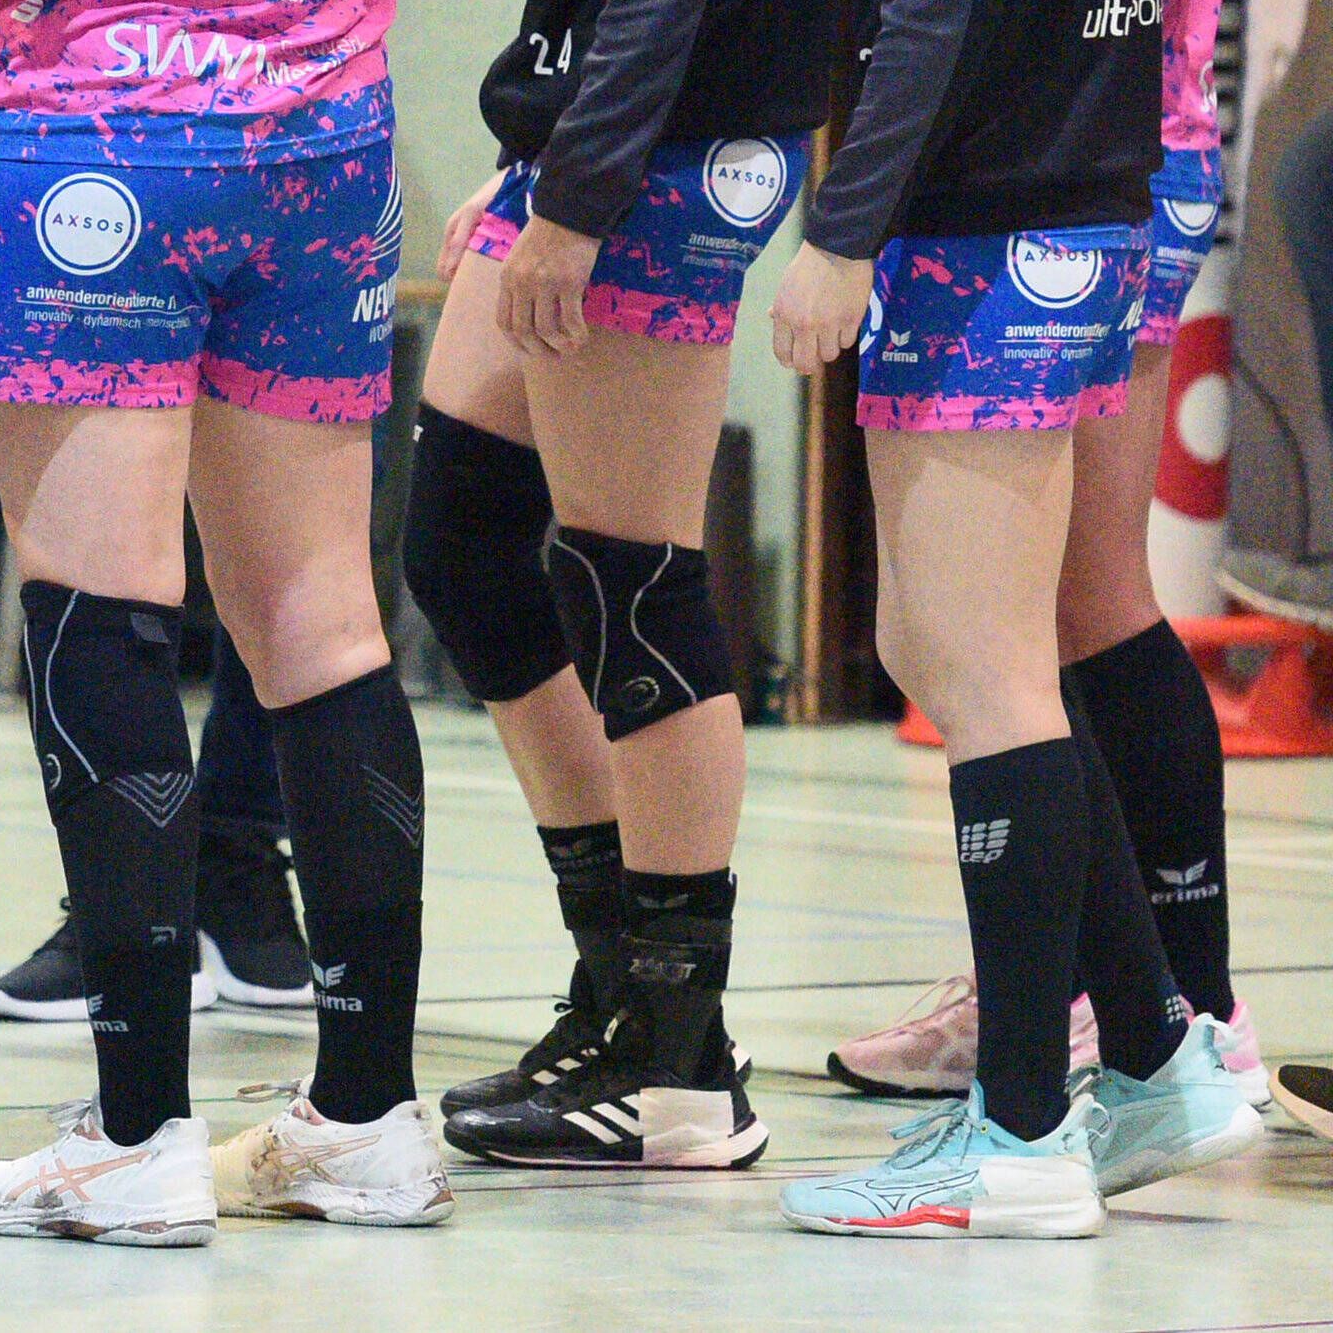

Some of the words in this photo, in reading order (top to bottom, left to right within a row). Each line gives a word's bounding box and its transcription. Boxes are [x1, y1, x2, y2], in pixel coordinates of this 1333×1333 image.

[529, 27, 574, 76] 24
[717, 166, 776, 190] AXSOS
[51, 211, 125, 235] AXSOS
[26, 285, 166, 309] anwenderorientierte
[24, 309, 75, 324] innovativ
[83, 314, 142, 330] dynamisch
[881, 349, 919, 365] erima
[1003, 346, 1053, 360] innovativ
[960, 848, 1005, 864] cep
[1151, 883, 1220, 905] erima
